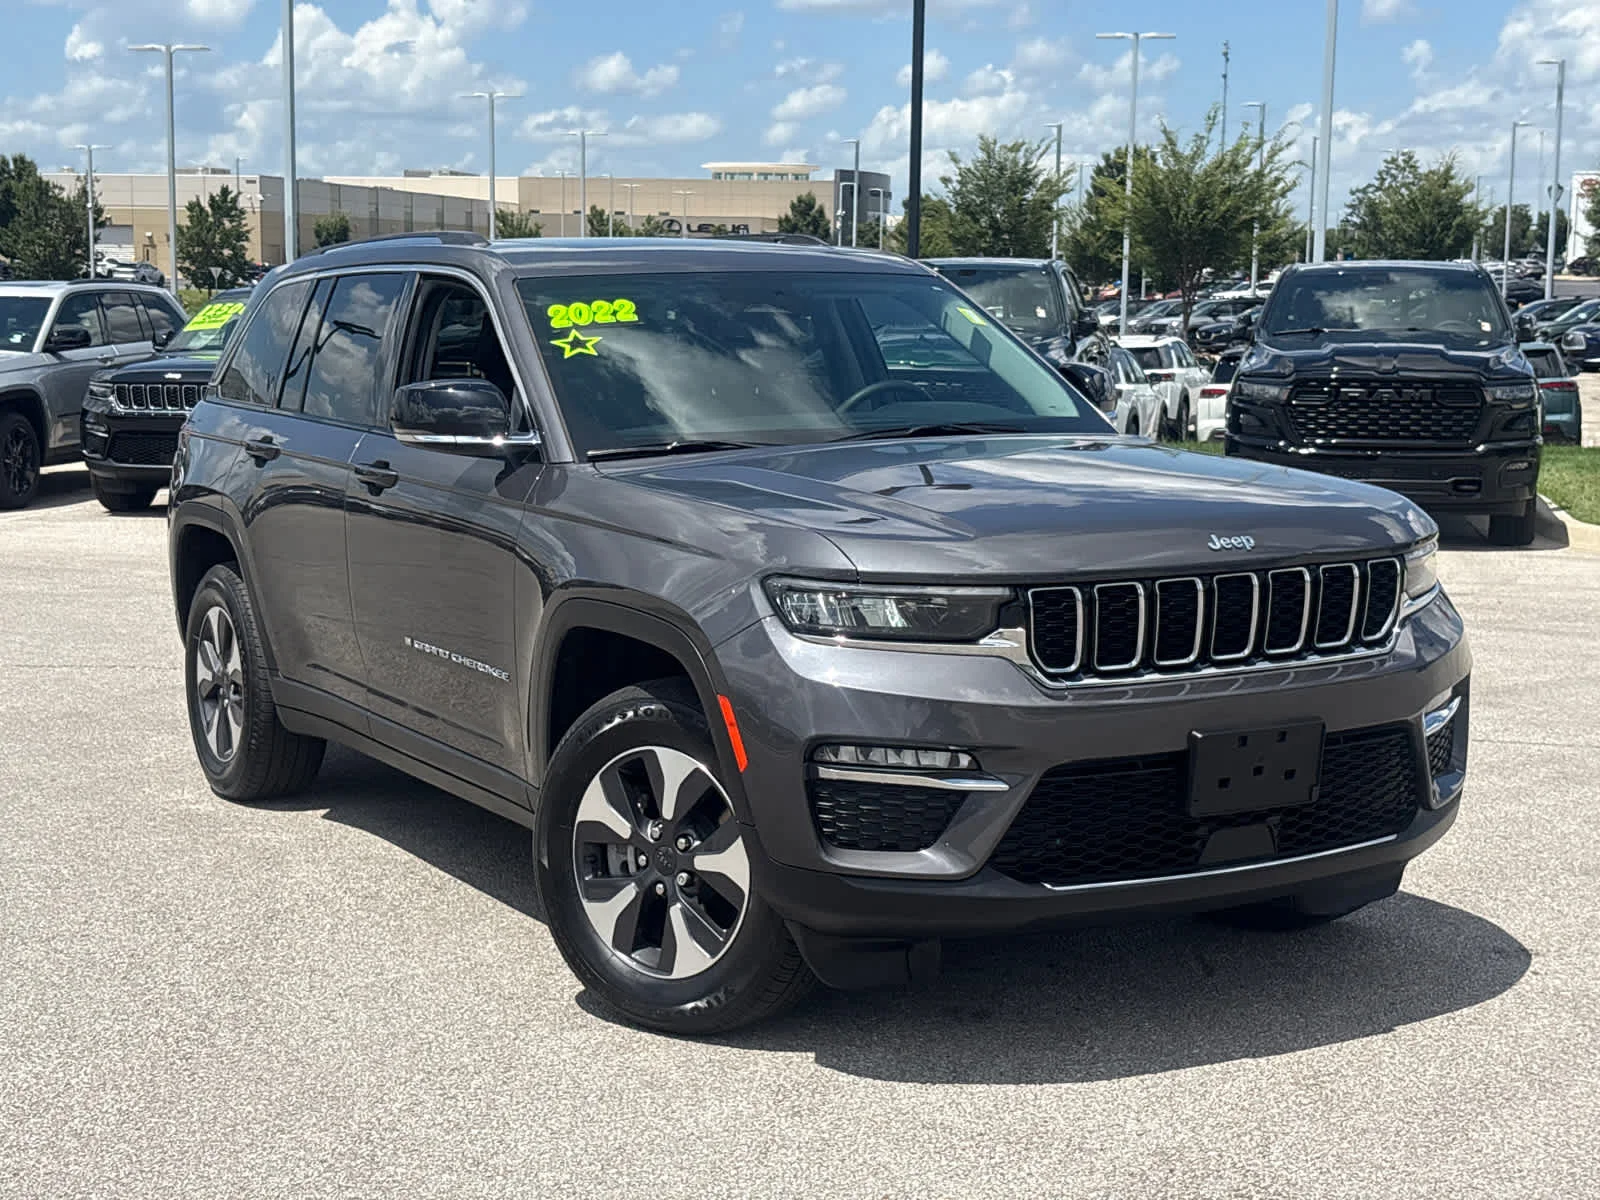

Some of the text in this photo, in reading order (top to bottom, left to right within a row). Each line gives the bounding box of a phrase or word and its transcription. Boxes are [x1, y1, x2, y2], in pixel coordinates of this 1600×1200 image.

[547, 298, 639, 329] 2022
[1339, 388, 1433, 402] RAM
[1208, 533, 1255, 550] Jeep
[451, 652, 510, 681] CHEROKEE
